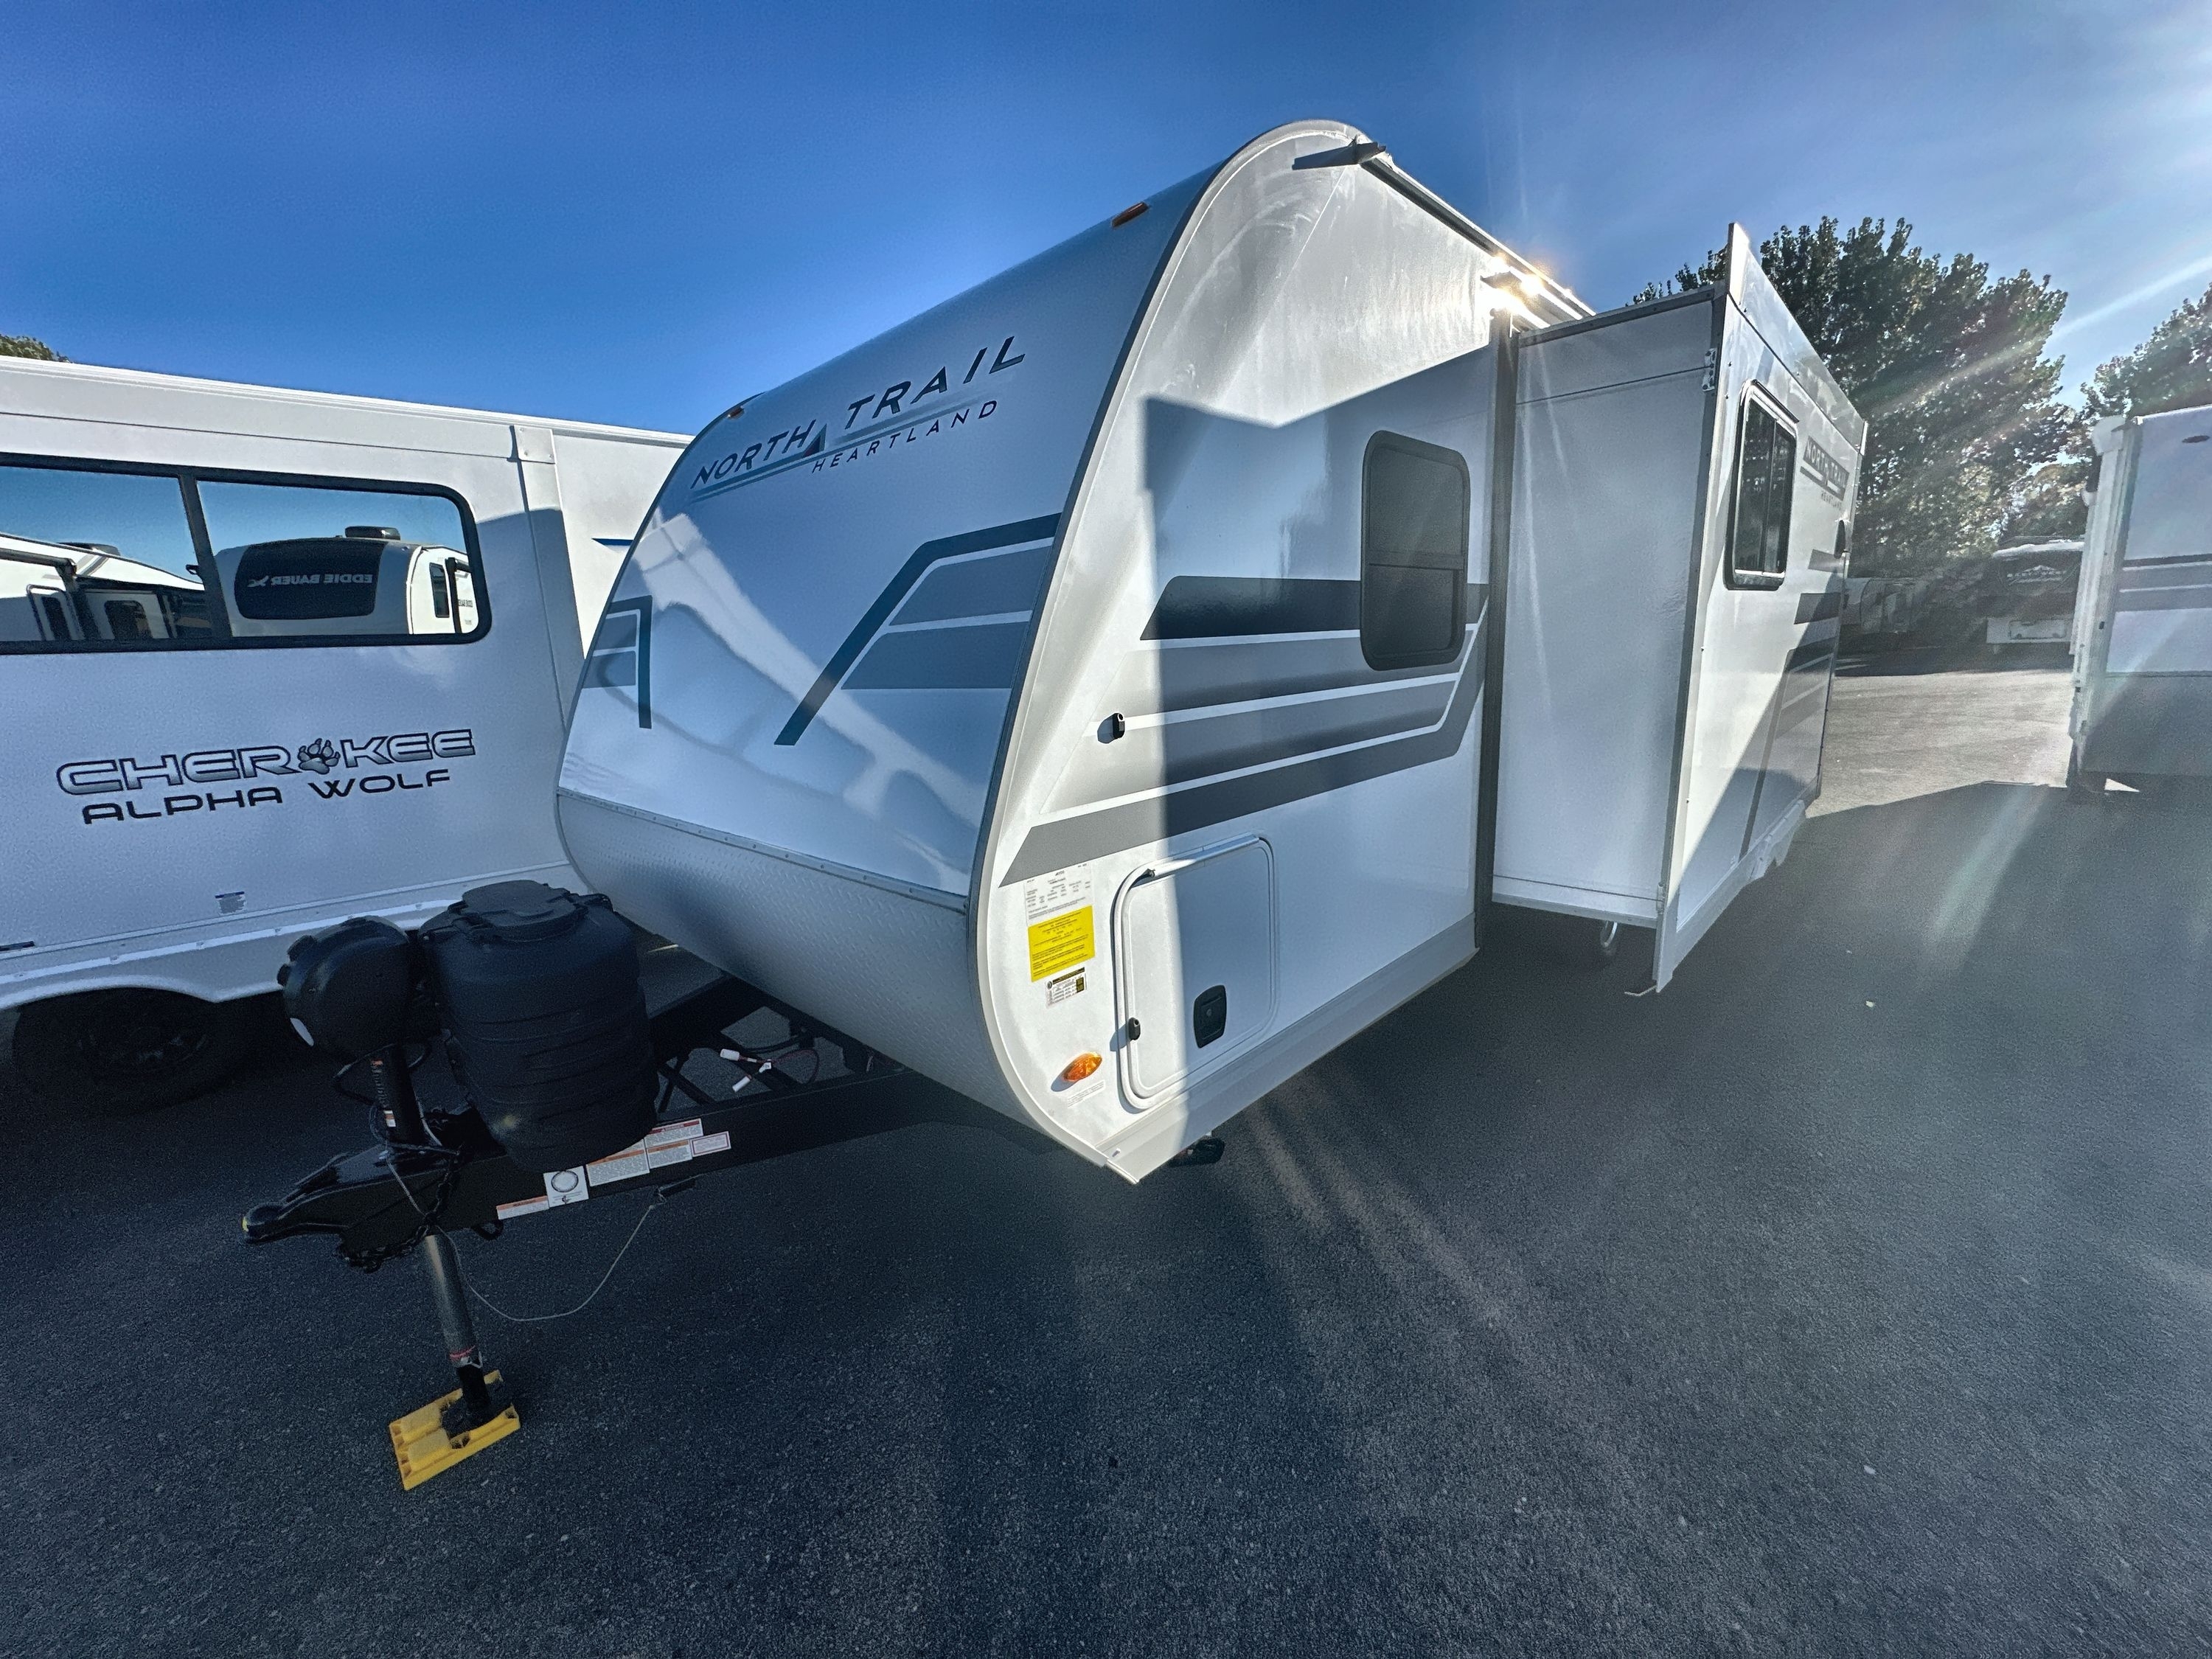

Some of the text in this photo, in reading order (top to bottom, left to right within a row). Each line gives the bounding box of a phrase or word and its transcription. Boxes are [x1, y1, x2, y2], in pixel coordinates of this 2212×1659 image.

[690, 335, 1026, 489] NORTH TRAIL
[812, 400, 998, 474] HEARTLAND
[82, 768, 452, 824] ALPHA WOLF
